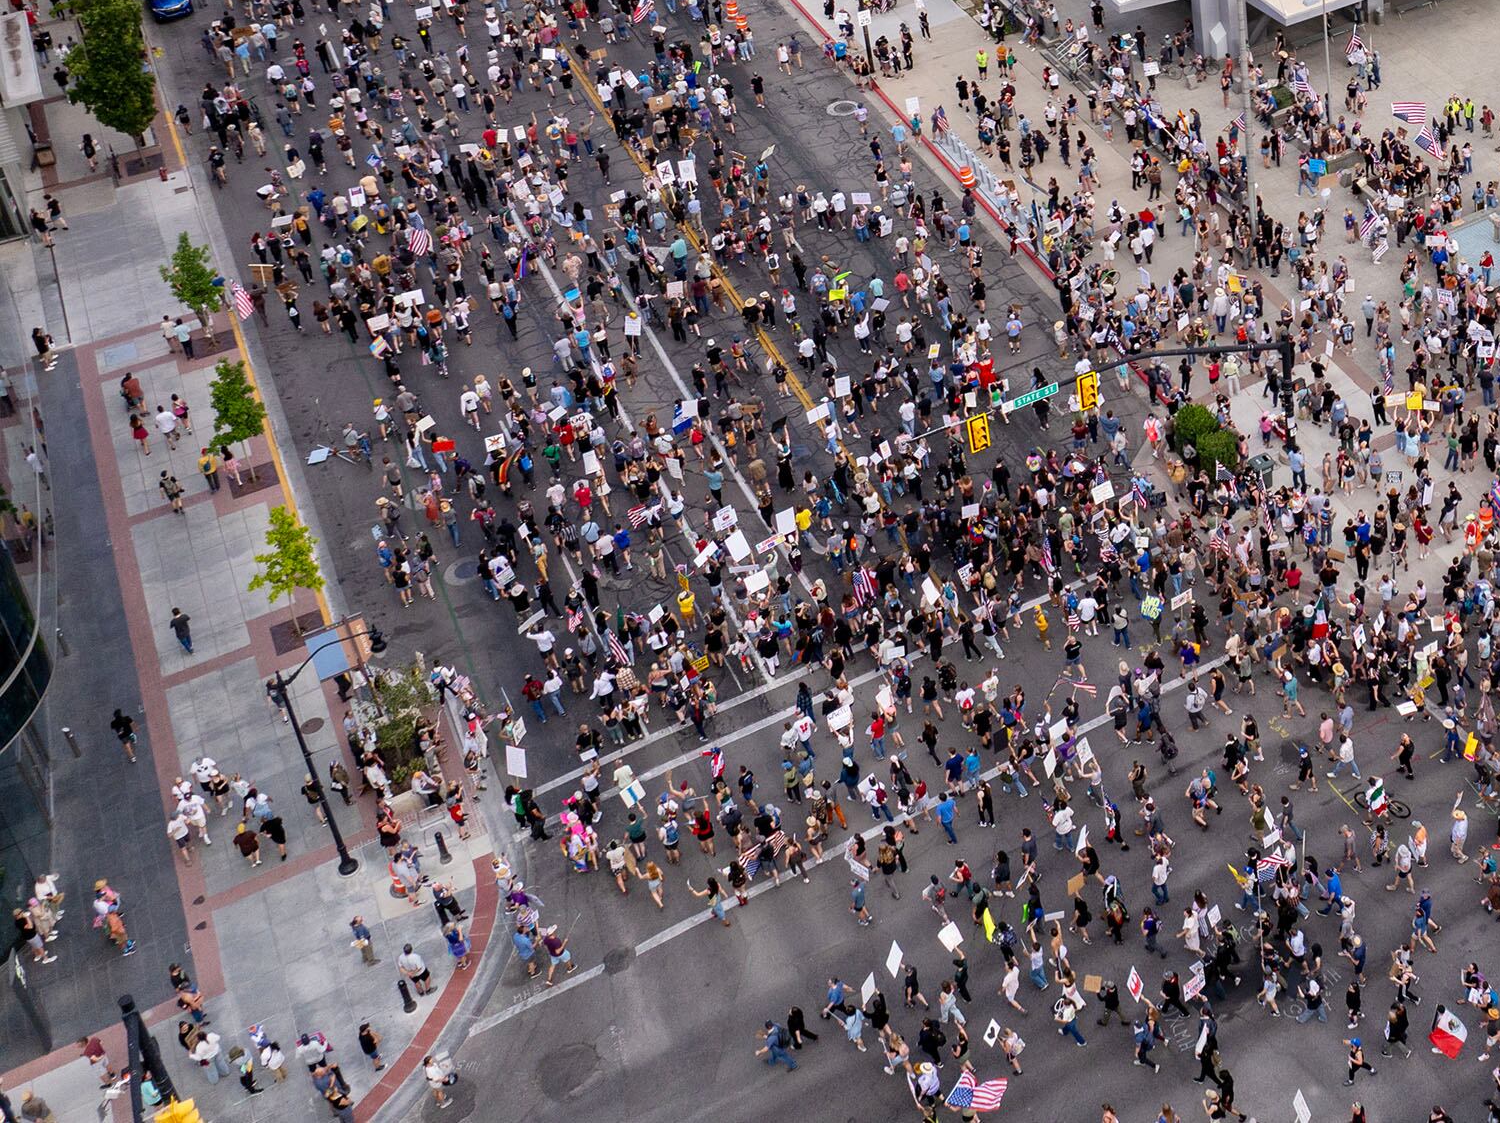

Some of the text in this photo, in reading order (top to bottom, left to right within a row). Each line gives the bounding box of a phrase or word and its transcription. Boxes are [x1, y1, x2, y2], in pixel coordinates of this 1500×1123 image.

[860, 17, 871, 25] 25
[1016, 386, 1055, 406] STATE ST
